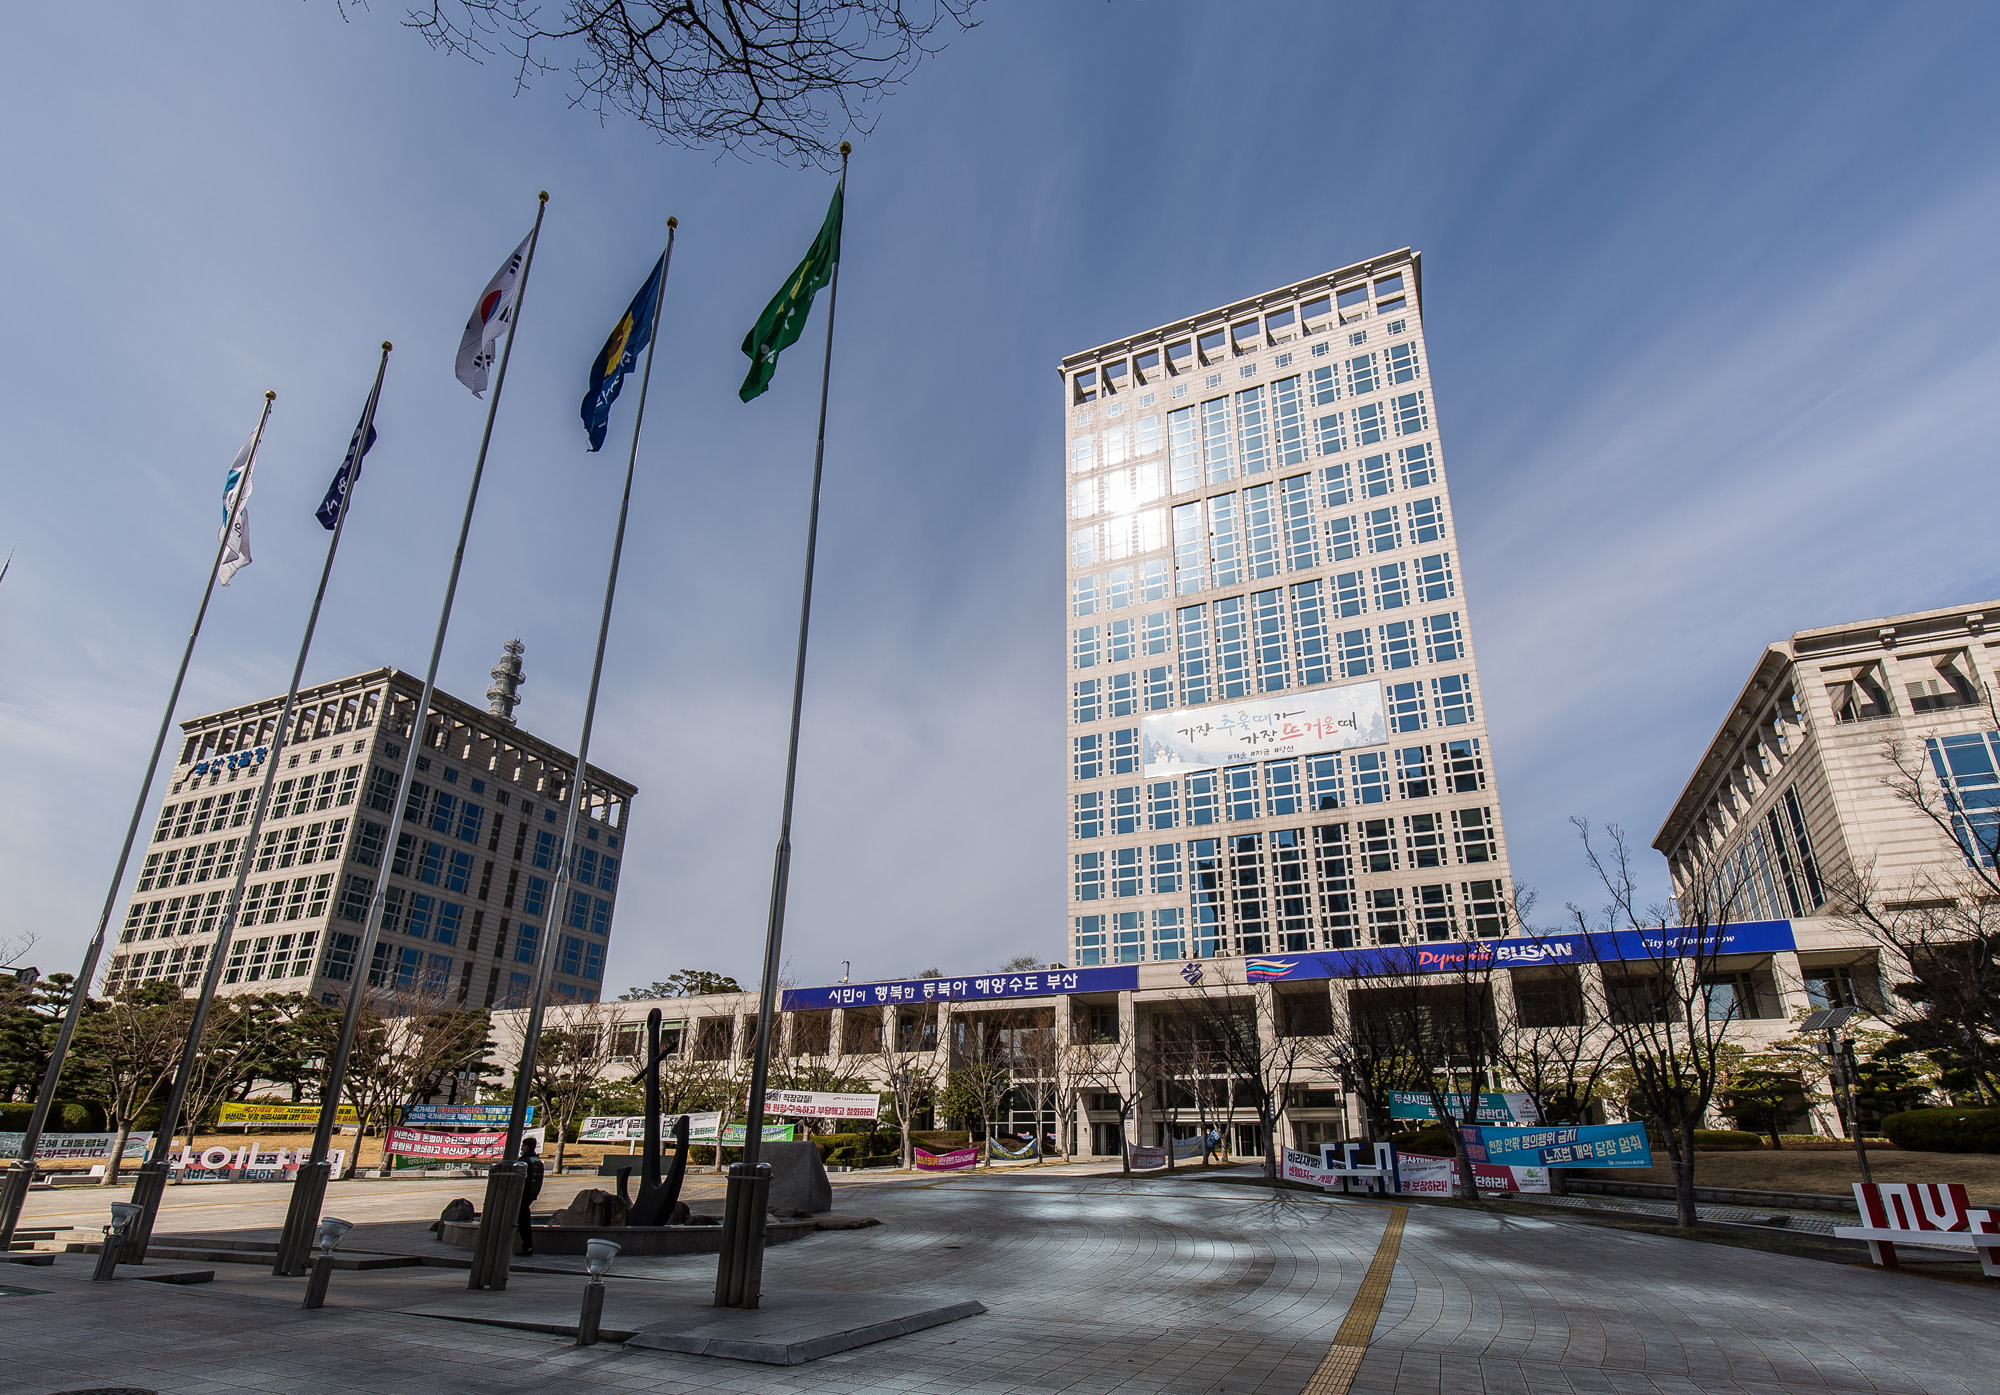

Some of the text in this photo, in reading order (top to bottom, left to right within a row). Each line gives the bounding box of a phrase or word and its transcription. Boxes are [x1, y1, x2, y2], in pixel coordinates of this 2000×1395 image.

[1177, 722, 1213, 743] 가장
[1240, 729, 1277, 744] 가장
[195, 747, 268, 776] 부산경찰청
[1666, 937, 1679, 948] of
[1496, 943, 1573, 961] BUSAN
[828, 988, 866, 1004] 시민이
[874, 984, 915, 1000] 행복한
[923, 980, 968, 999] 동북아
[1046, 972, 1078, 990] 부산
[393, 1130, 499, 1145] 어르신을 돈벌이 수단으로 이용하는
[1488, 1140, 1503, 1154] 현장
[1504, 1136, 1521, 1152] 안팎
[1521, 1131, 1557, 1149] 쟁의행위
[1558, 1128, 1578, 1144] 금지
[441, 1146, 470, 1156] 부산시가
[1545, 1147, 1572, 1164] 노조법
[1595, 1139, 1616, 1157] 당장
[1618, 1134, 1643, 1153] 멈춰
[1411, 1180, 1448, 1192] 보장하라!
